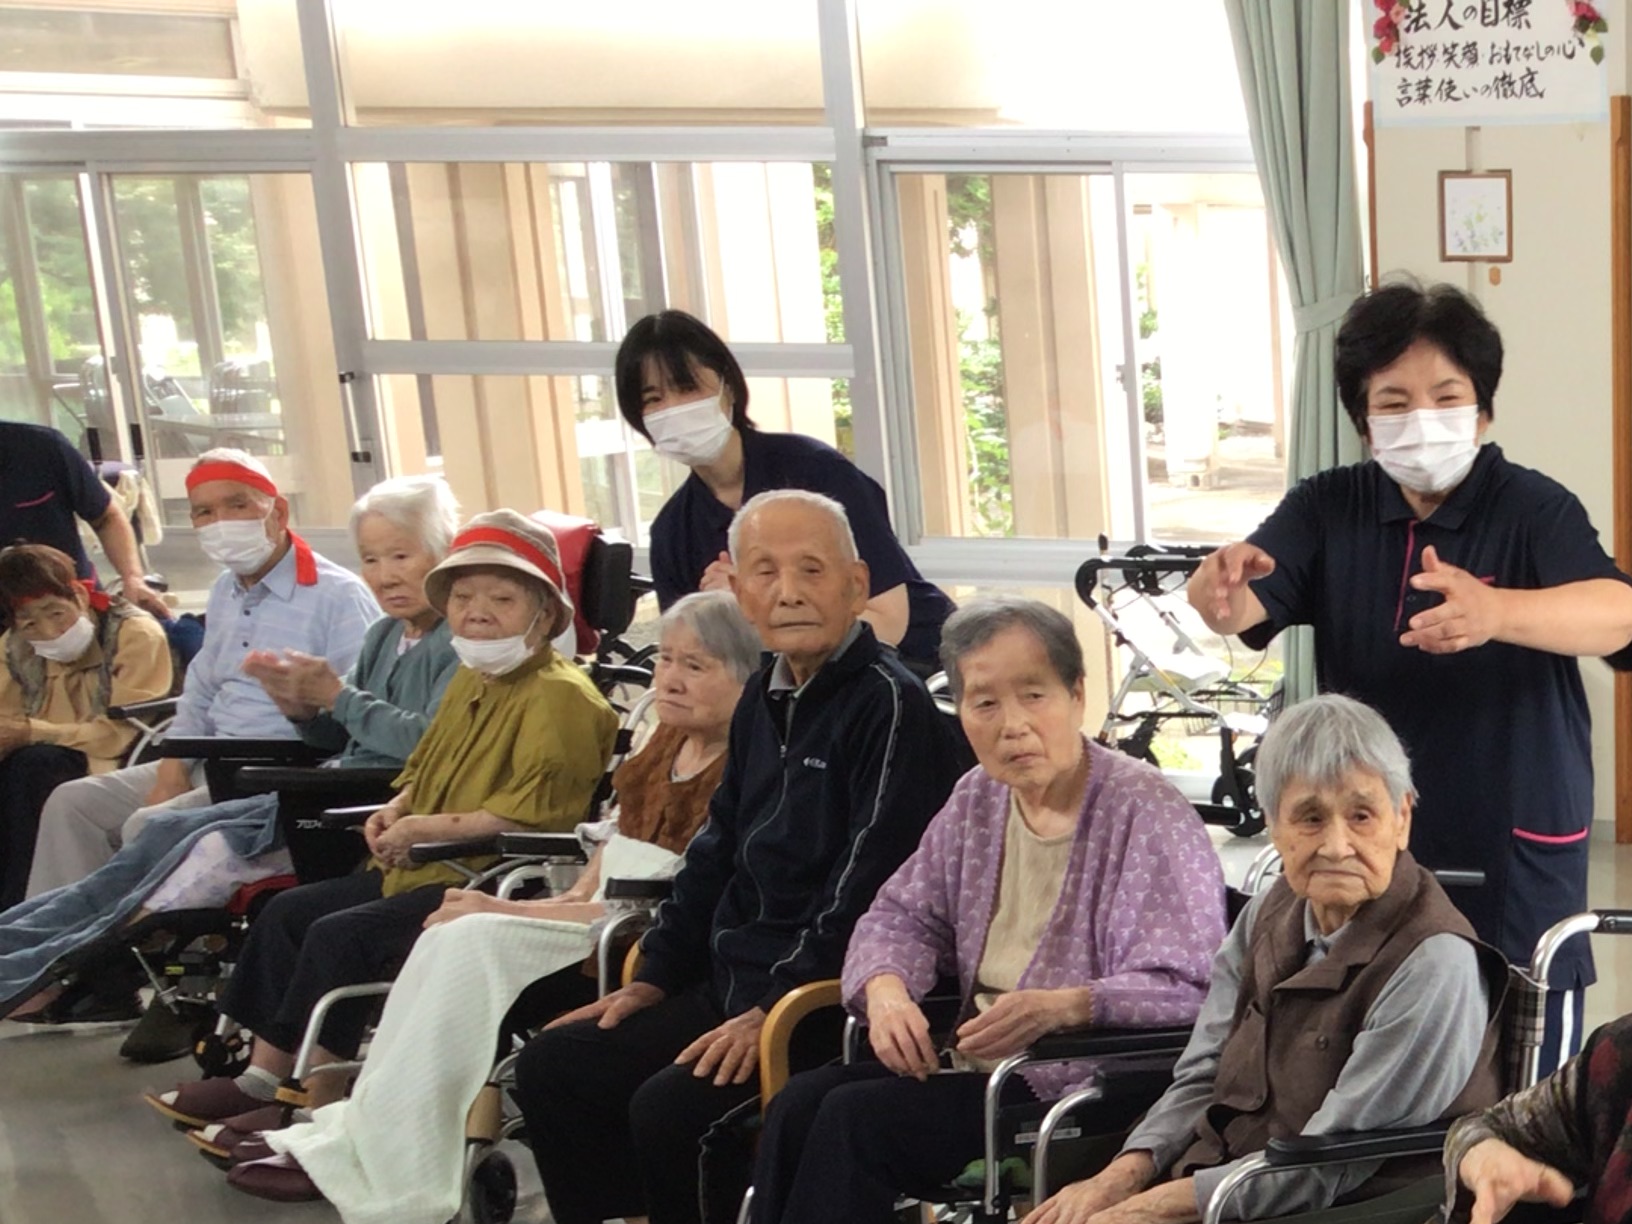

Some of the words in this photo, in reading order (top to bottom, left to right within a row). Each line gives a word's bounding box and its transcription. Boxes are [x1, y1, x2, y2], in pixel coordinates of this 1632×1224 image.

[1404, 0, 1532, 33] 法人の目標
[1396, 67, 1546, 108] 言葉使いの徹底
